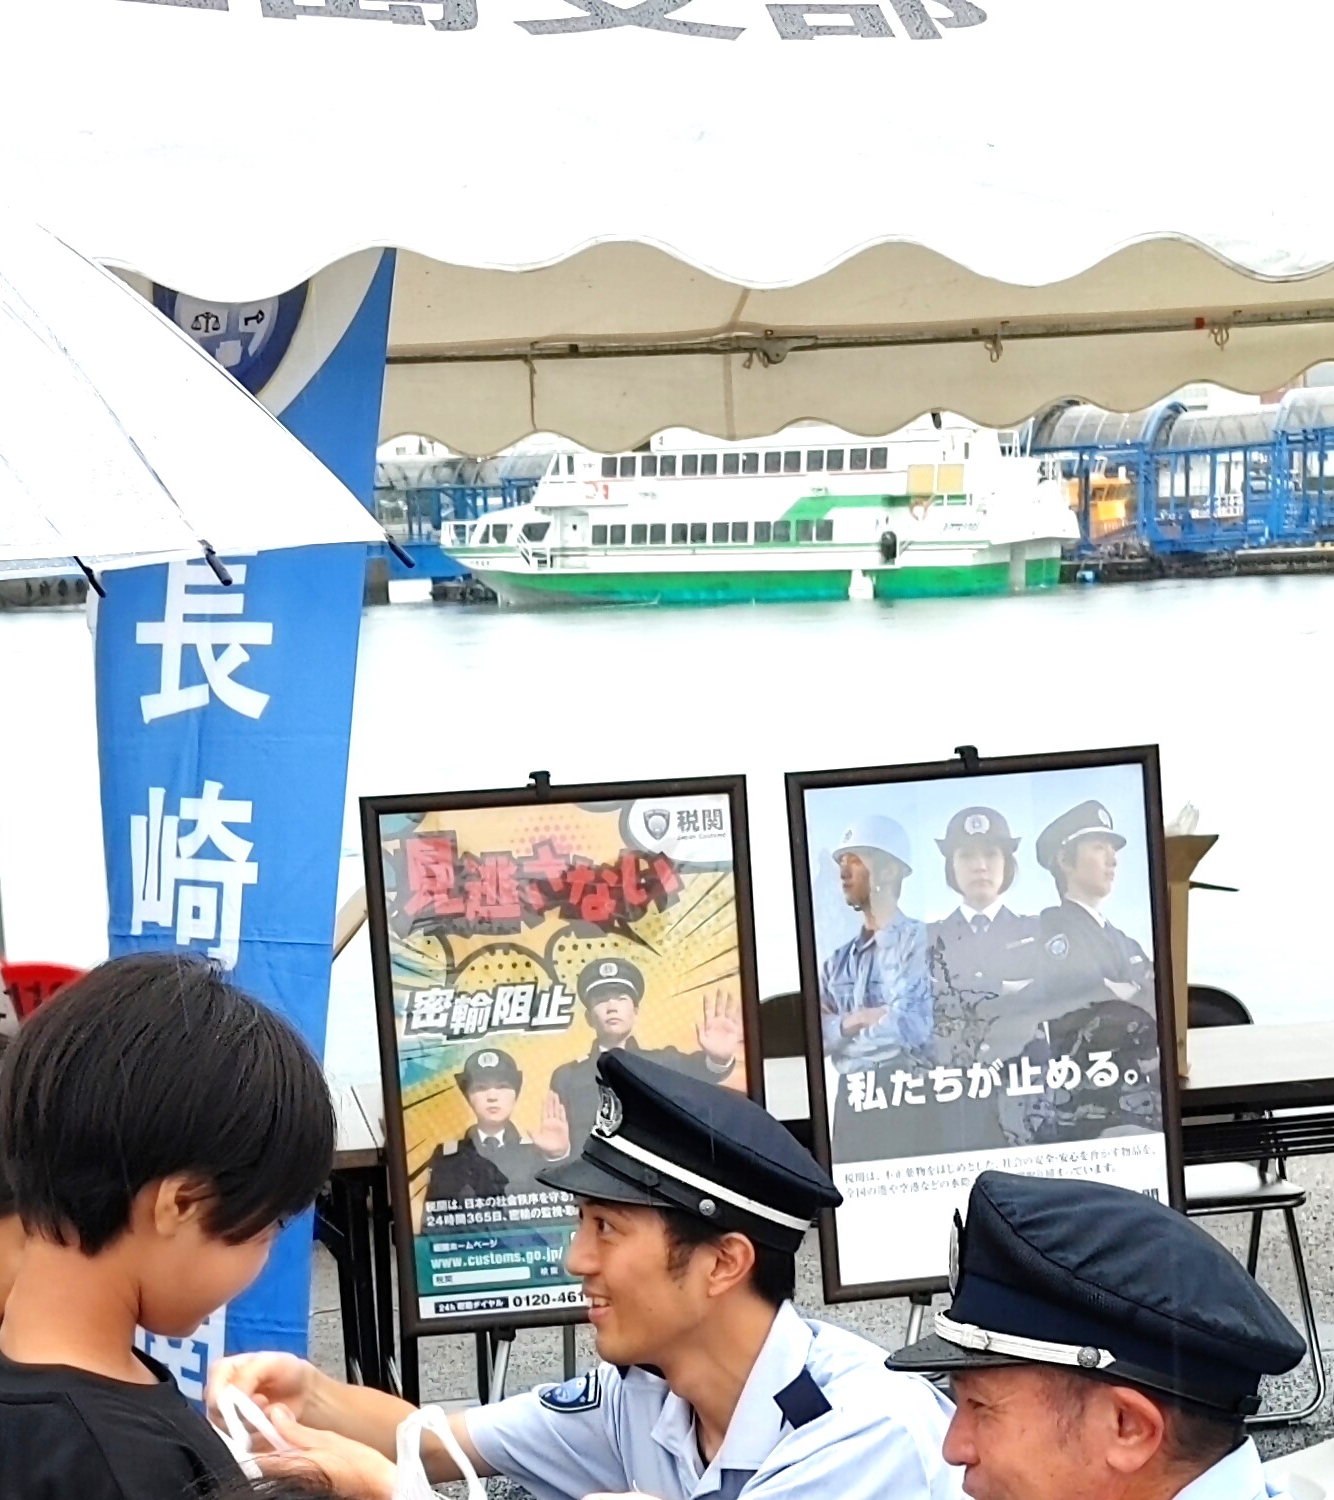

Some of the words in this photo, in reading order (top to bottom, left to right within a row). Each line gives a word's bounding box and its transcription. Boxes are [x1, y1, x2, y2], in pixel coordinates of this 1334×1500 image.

[676, 808, 724, 833] 税関
[404, 837, 679, 921] 見逃さない
[410, 984, 575, 1035] 密輸阻止
[846, 1051, 1139, 1113] 私たちが止める。
